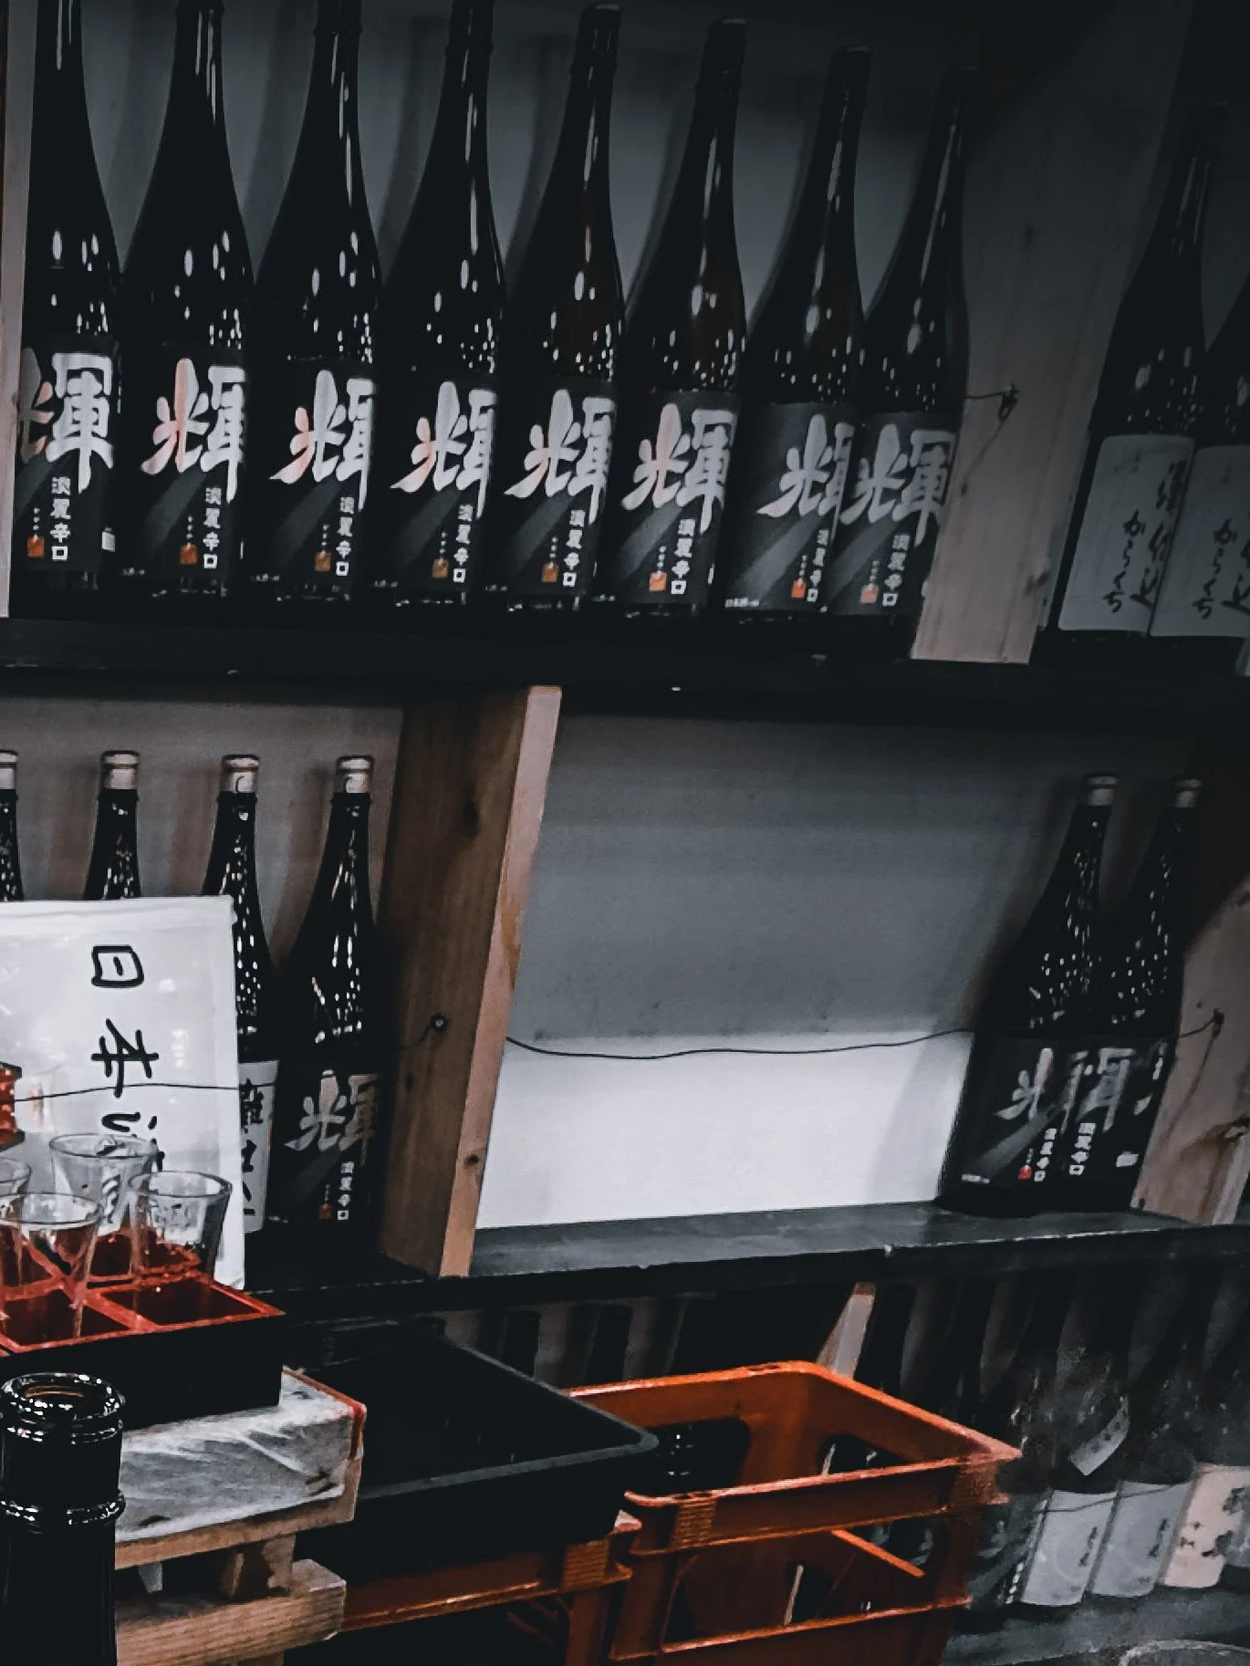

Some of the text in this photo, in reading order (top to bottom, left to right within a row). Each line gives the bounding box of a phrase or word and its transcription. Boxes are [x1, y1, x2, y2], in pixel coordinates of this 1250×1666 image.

[141, 357, 246, 503] 輝
[269, 370, 376, 512] 輝
[390, 380, 498, 519] 輝
[504, 389, 617, 522] 輝
[622, 403, 739, 532] 輝
